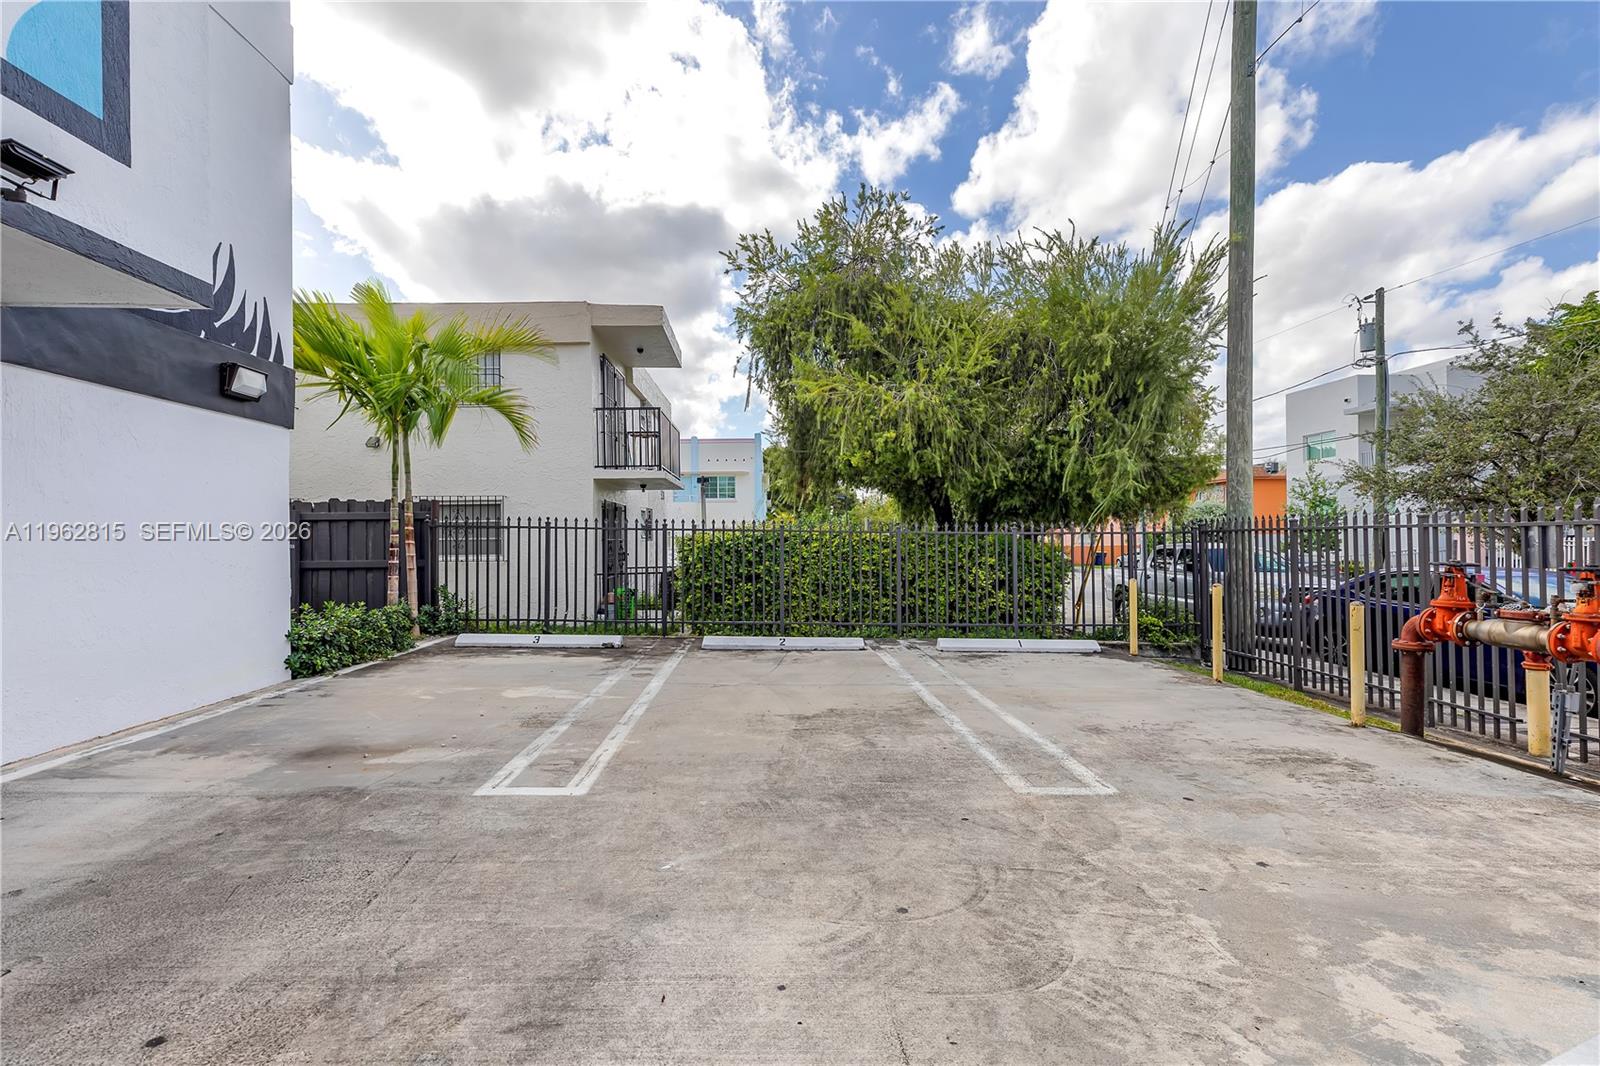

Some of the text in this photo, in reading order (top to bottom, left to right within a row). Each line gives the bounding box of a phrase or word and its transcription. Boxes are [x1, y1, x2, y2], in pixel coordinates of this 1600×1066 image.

[532, 635, 541, 644] 3
[779, 638, 786, 646] 2
[1017, 639, 1023, 648] 1
